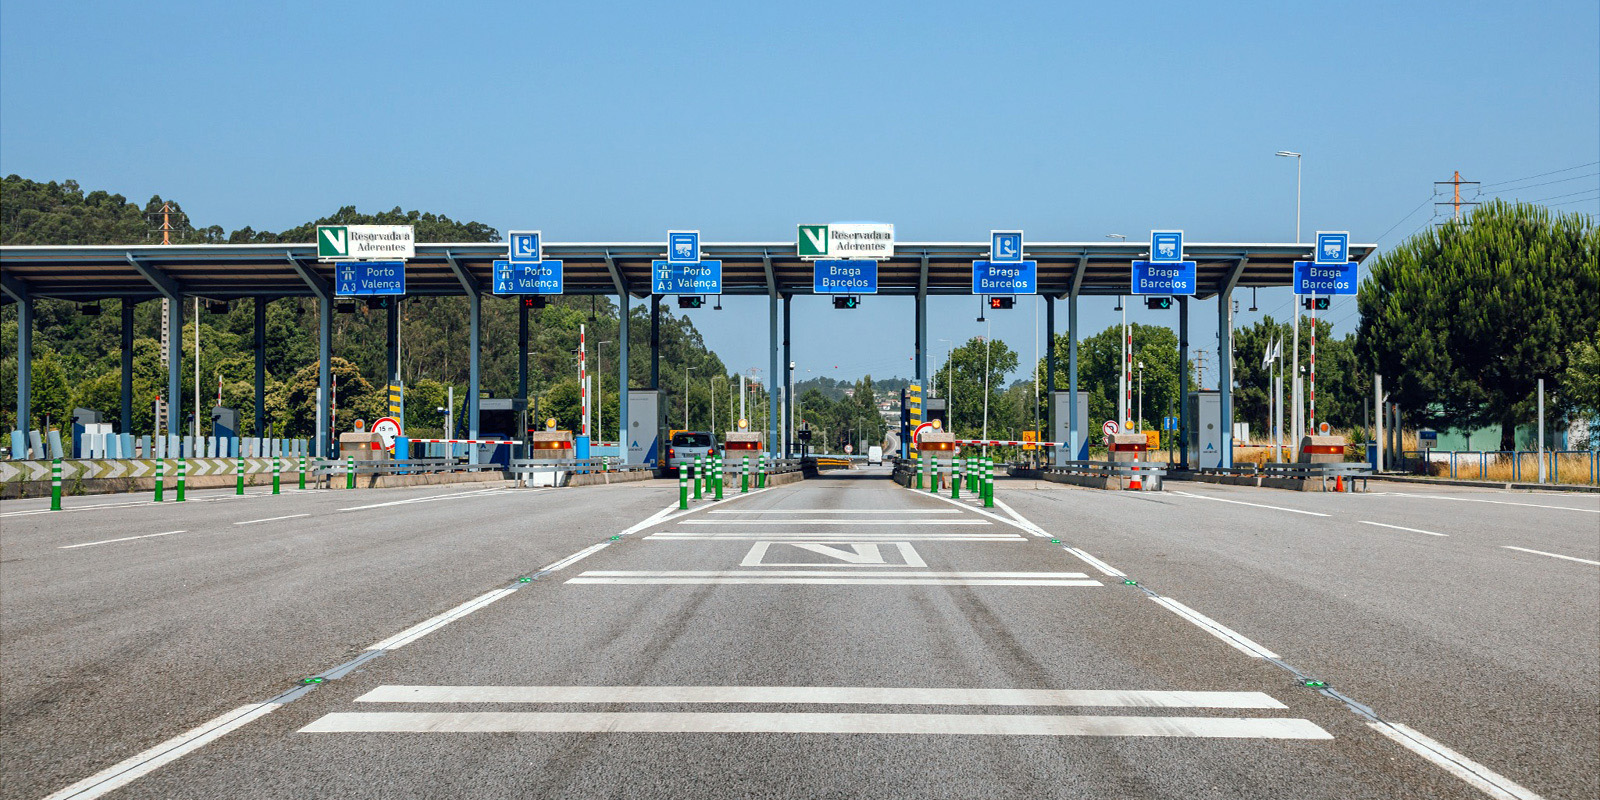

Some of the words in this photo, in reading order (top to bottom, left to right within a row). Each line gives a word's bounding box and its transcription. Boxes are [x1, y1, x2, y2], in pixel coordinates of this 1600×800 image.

[351, 231, 402, 241] Reservada
[831, 230, 882, 240] Reservada
[357, 242, 406, 252] Aderentes
[837, 241, 886, 251] Aderentes
[367, 267, 395, 277] Porto
[525, 266, 553, 276] Porto
[683, 266, 711, 276] Porto
[830, 266, 862, 278] Braga
[988, 266, 1020, 278] Braga
[1147, 267, 1179, 279] Braga
[1309, 267, 1341, 279] Braga
[341, 283, 349, 292] A
[350, 283, 357, 292] 3
[361, 279, 401, 291] Valença
[499, 282, 507, 291] A
[508, 282, 515, 291] 3
[519, 278, 559, 290] Valença
[657, 282, 665, 291] A
[666, 282, 673, 291] 3
[677, 278, 717, 290] Valença
[822, 277, 869, 288] Barcelos
[980, 277, 1027, 288] Barcelos
[1139, 278, 1186, 289] Barcelos
[1301, 278, 1348, 289] Barcelos
